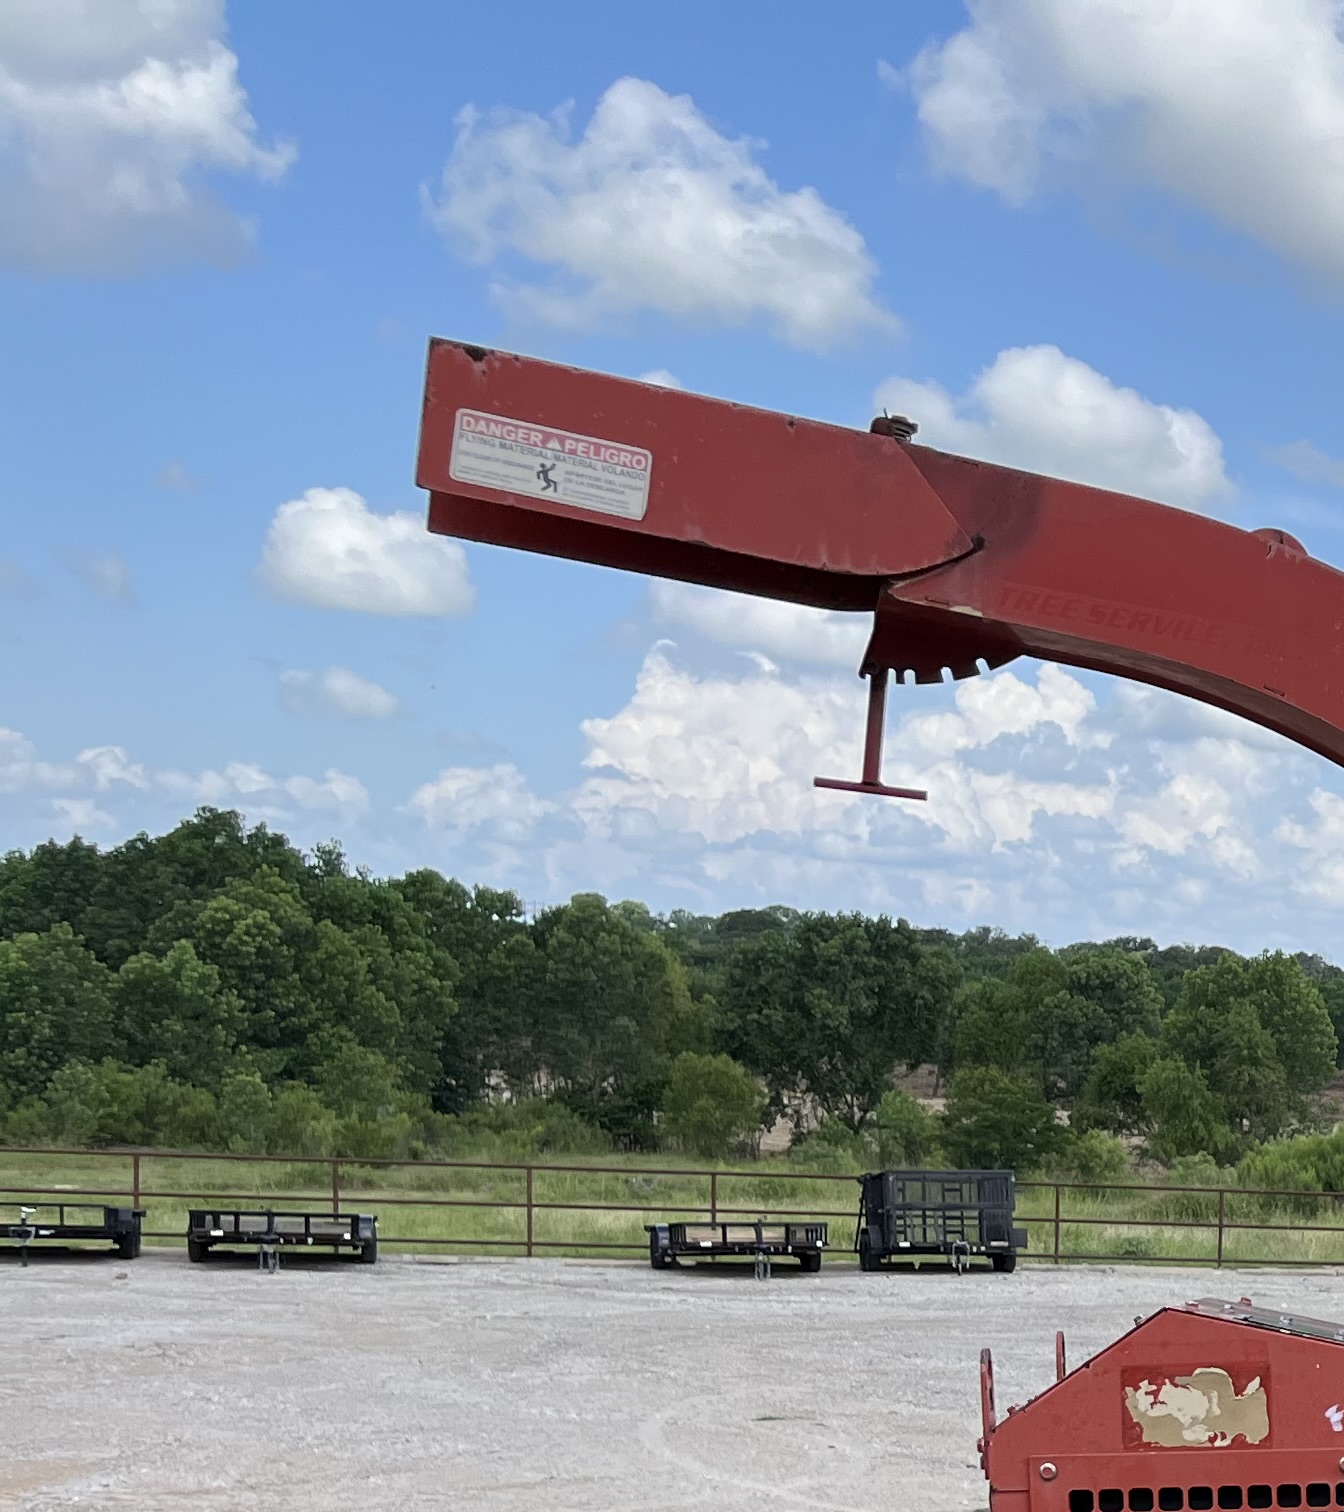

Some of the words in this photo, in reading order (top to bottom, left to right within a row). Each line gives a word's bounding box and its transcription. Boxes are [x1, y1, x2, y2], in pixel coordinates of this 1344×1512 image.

[461, 415, 543, 447] DANGER
[564, 438, 646, 470] PELIGRO
[997, 586, 1081, 618] TREE
